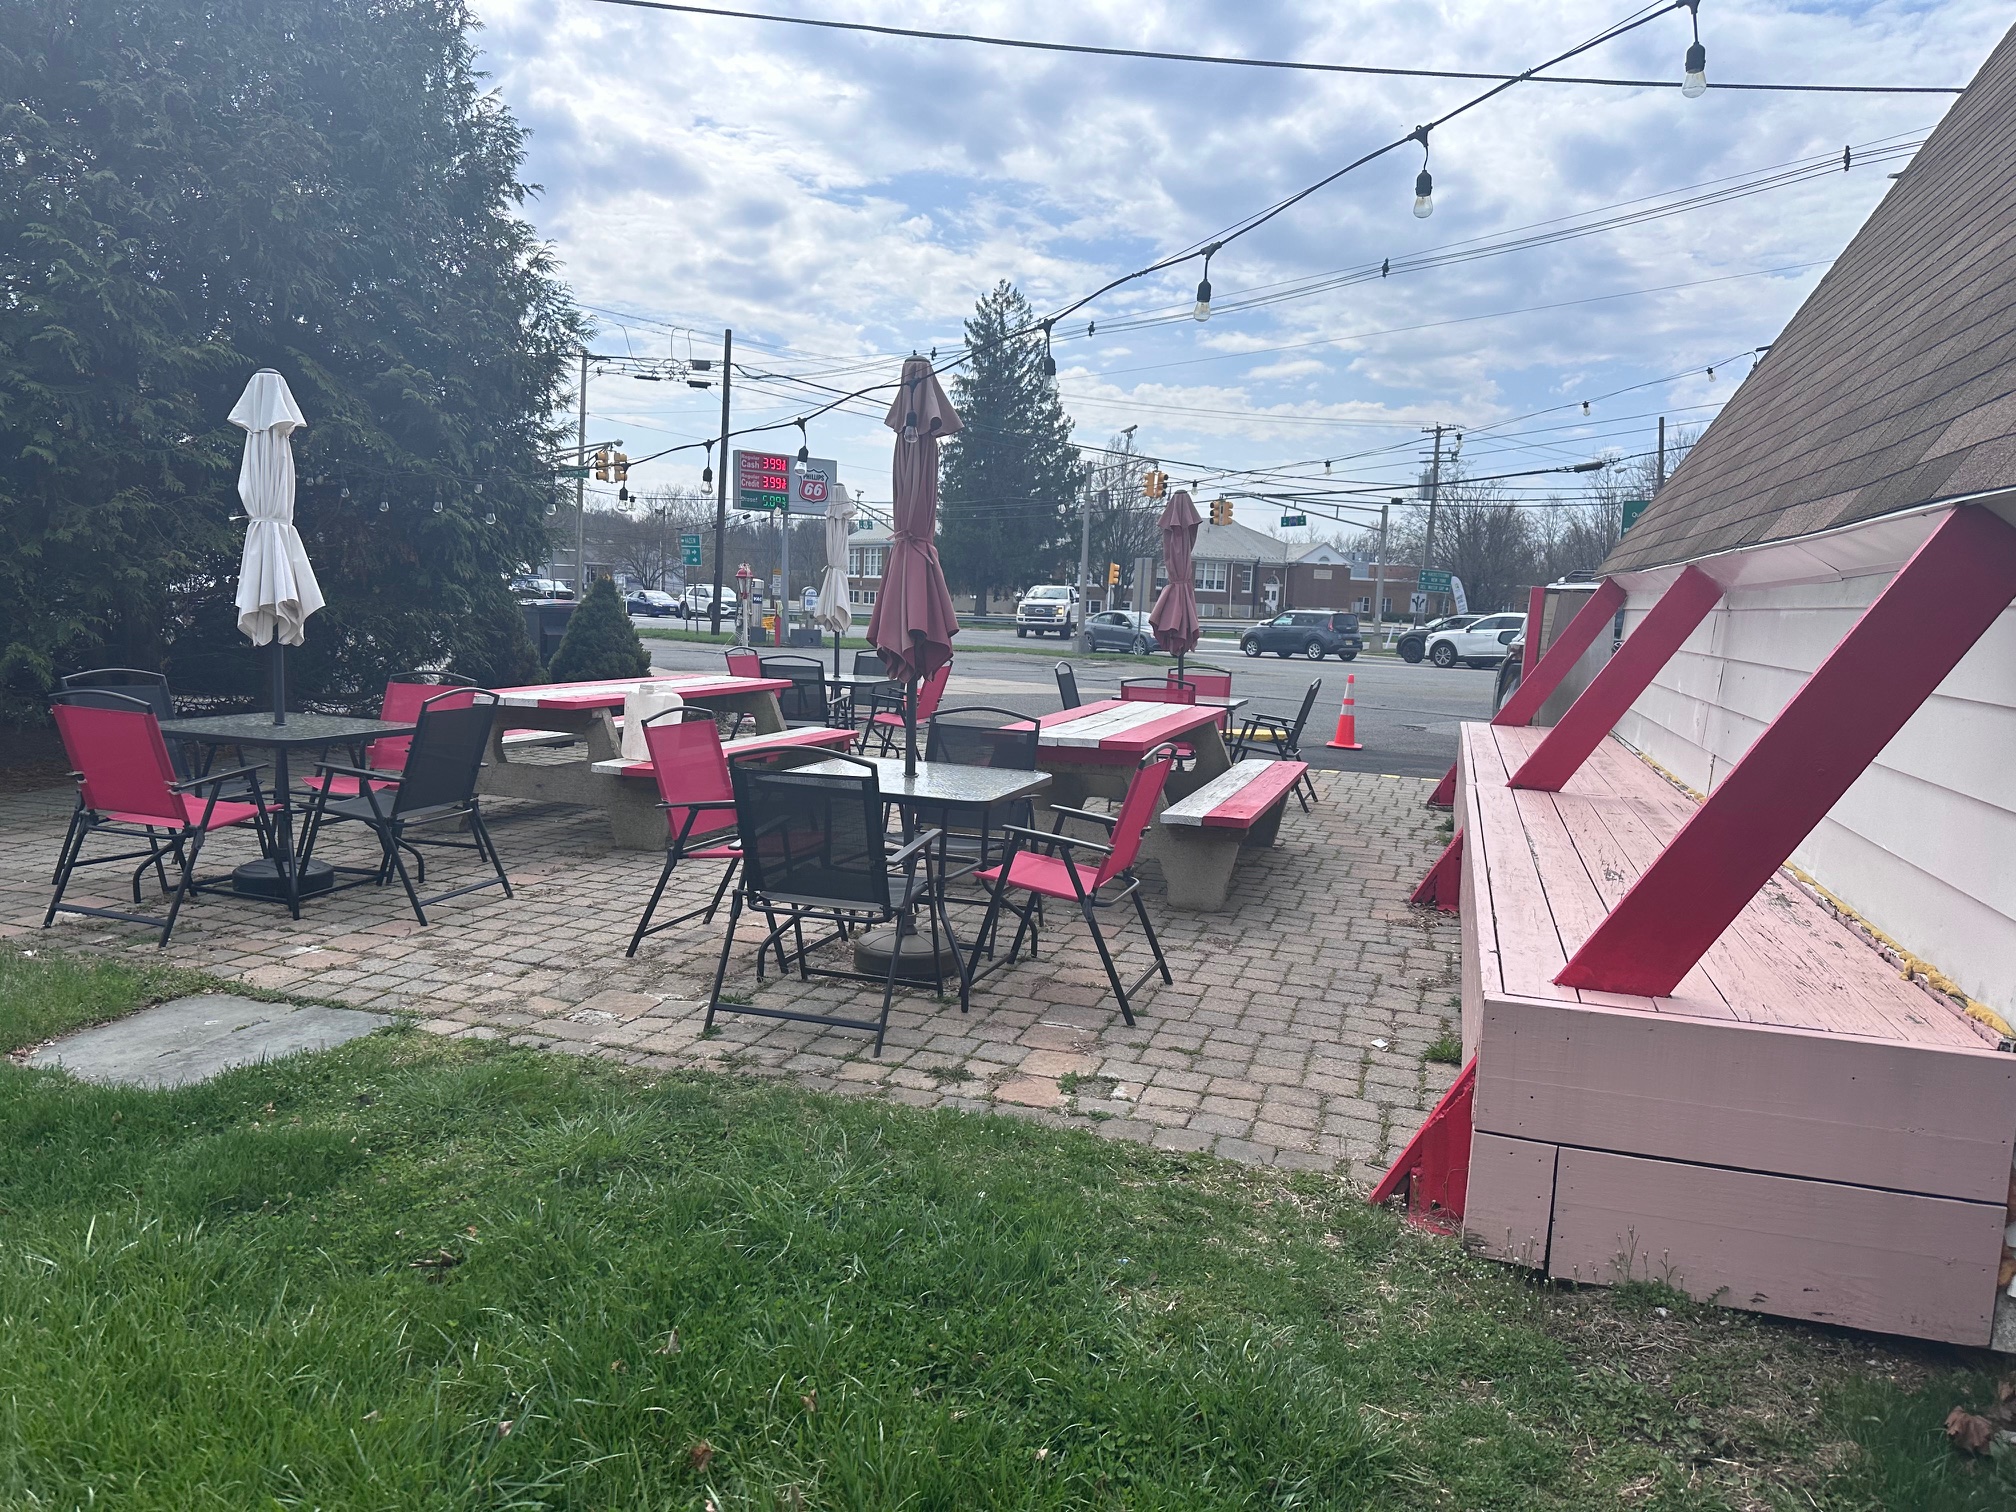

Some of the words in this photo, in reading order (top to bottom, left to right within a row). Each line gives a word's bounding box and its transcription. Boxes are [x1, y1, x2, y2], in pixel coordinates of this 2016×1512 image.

[741, 459, 760, 469] Cash
[741, 478, 760, 488] Credit
[804, 482, 823, 496] 66
